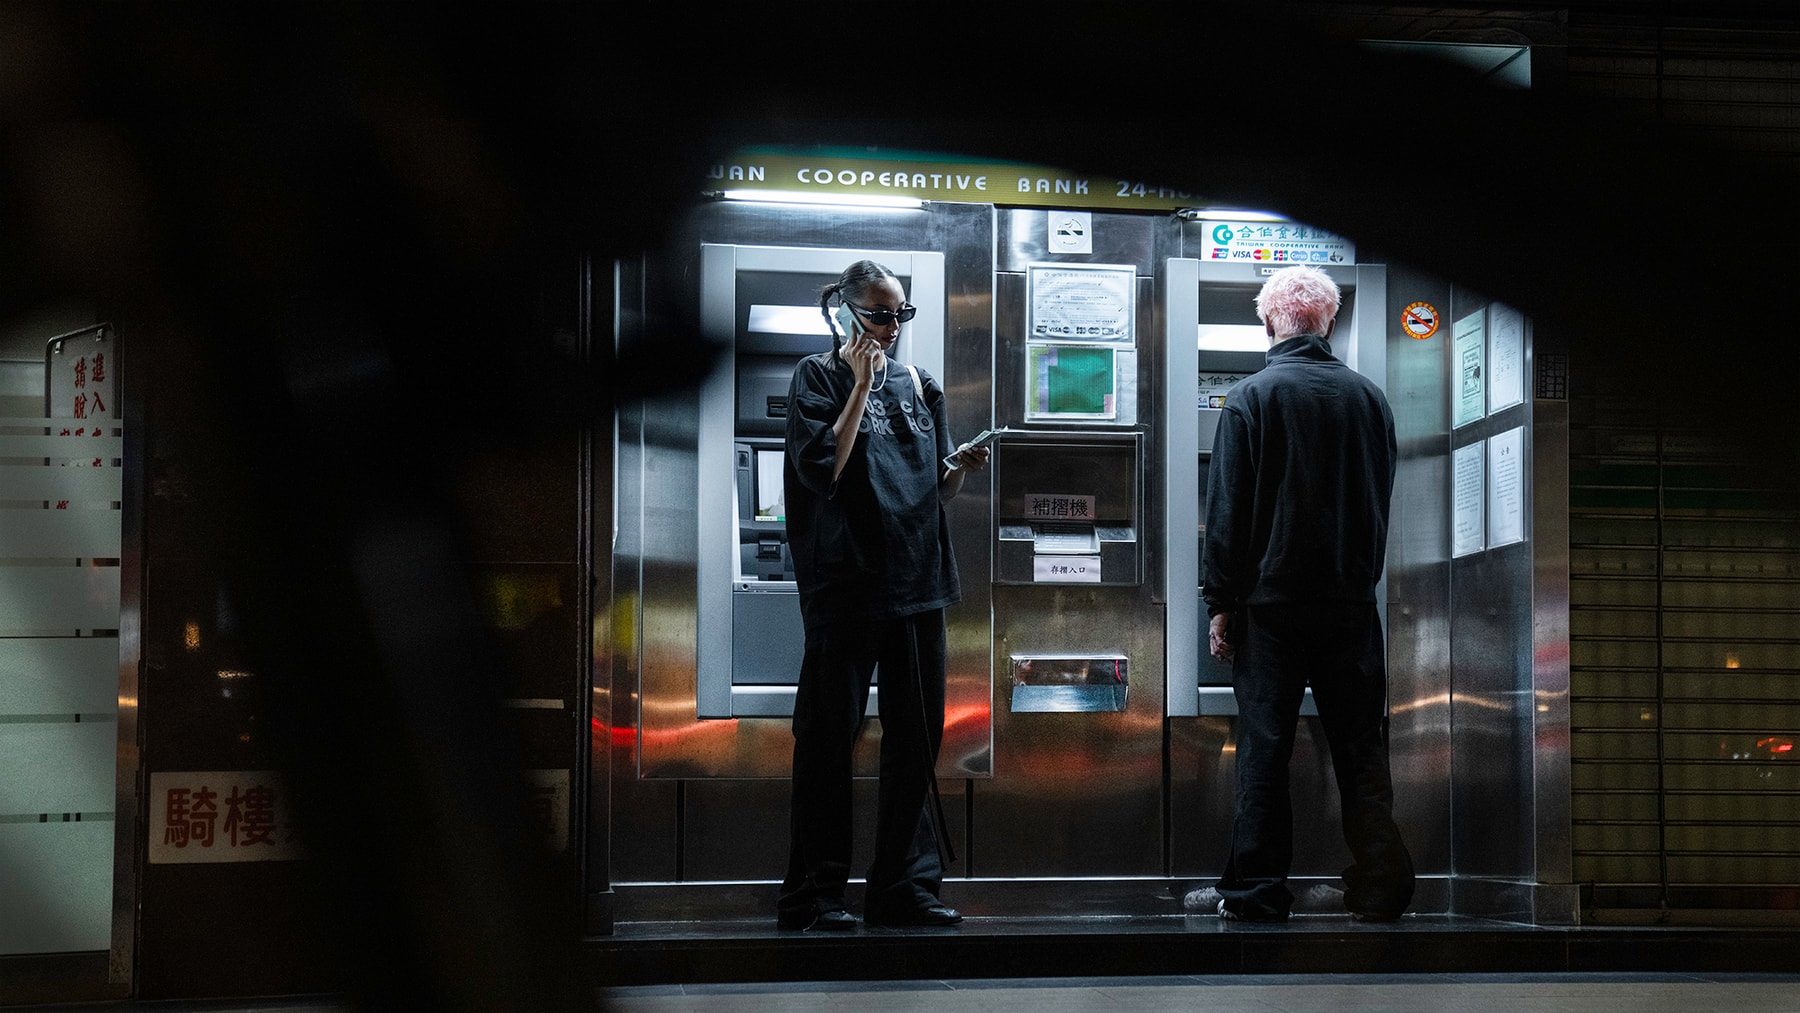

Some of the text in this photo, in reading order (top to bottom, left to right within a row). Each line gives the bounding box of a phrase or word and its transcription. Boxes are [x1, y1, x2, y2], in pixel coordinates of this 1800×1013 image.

[797, 168, 987, 191] COOPERATIVE
[1018, 177, 1089, 195] BANK
[1232, 250, 1250, 258] VISA
[1032, 498, 1089, 517] 補摺機
[1050, 565, 1086, 575] 存摺入口
